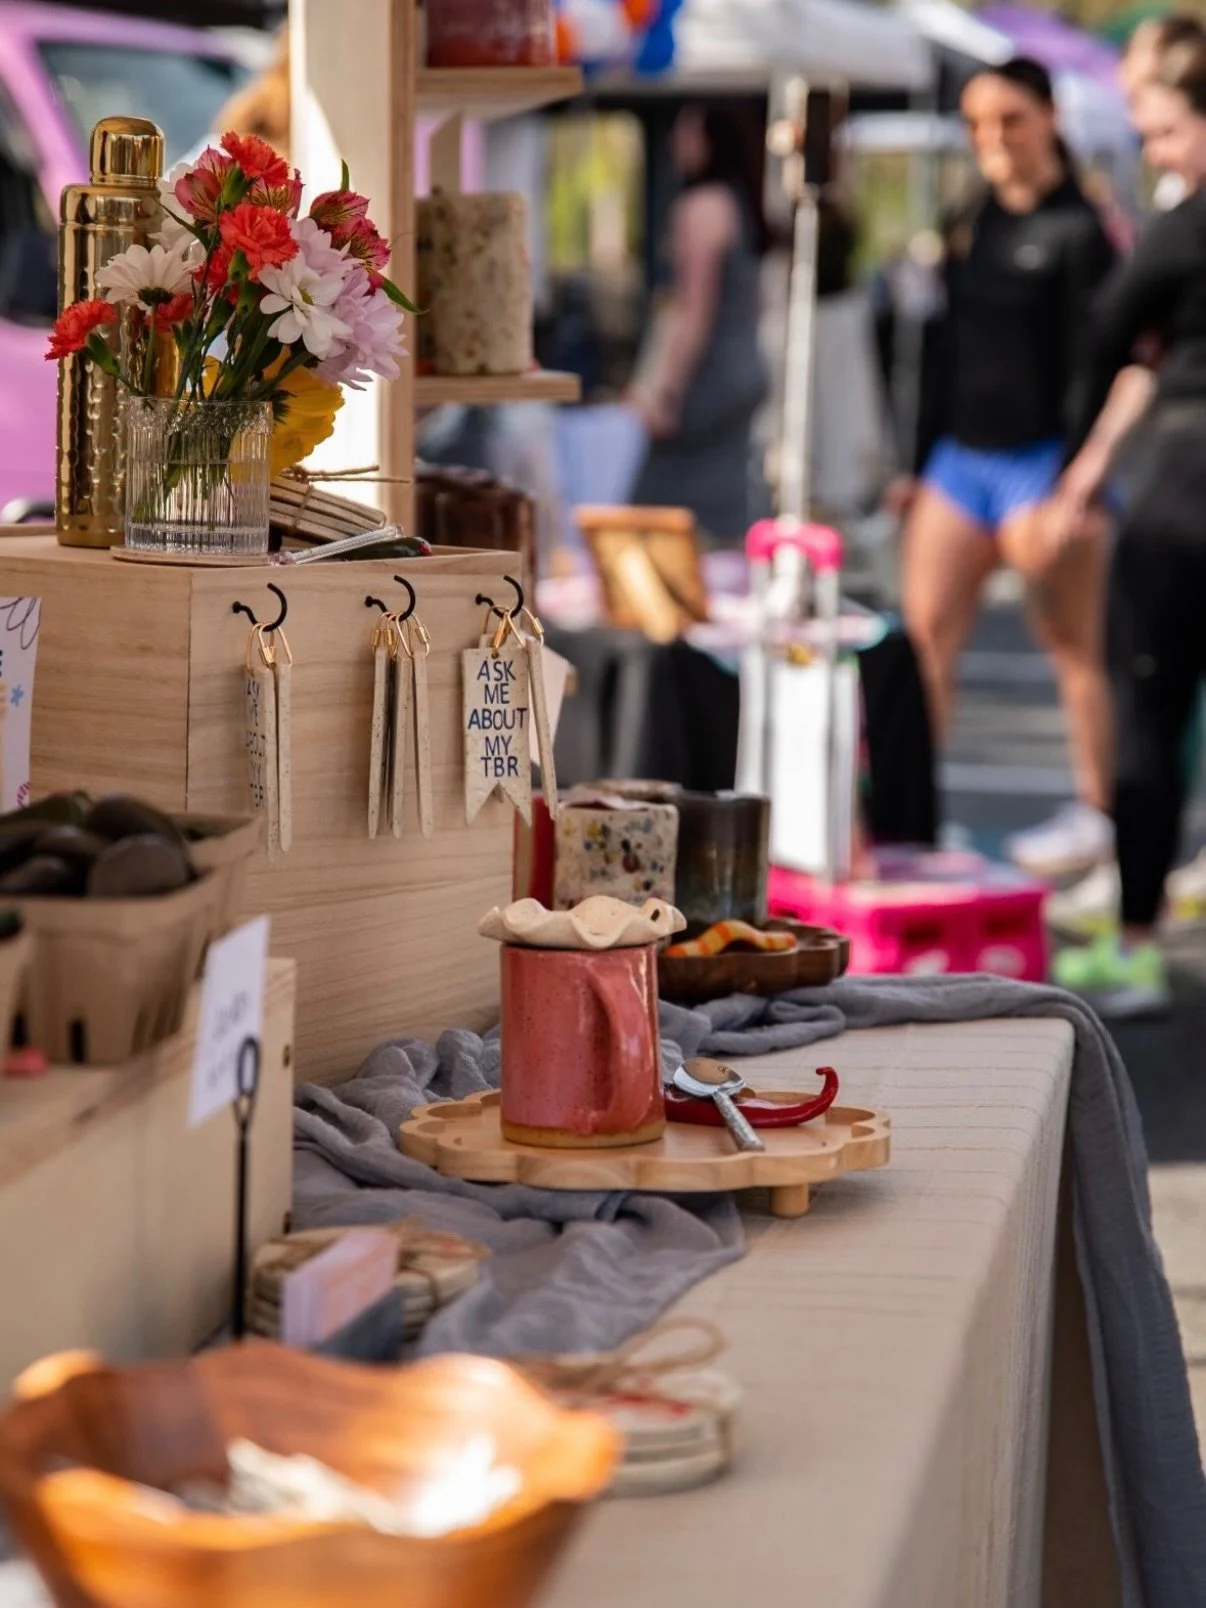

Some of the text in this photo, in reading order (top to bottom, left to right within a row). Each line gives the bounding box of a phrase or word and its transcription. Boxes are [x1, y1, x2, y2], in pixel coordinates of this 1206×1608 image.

[477, 660, 516, 681] ASK
[484, 683, 510, 704] ME
[468, 708, 527, 730] ABOUT
[485, 736, 512, 756] MY
[481, 757, 519, 777] TBR
